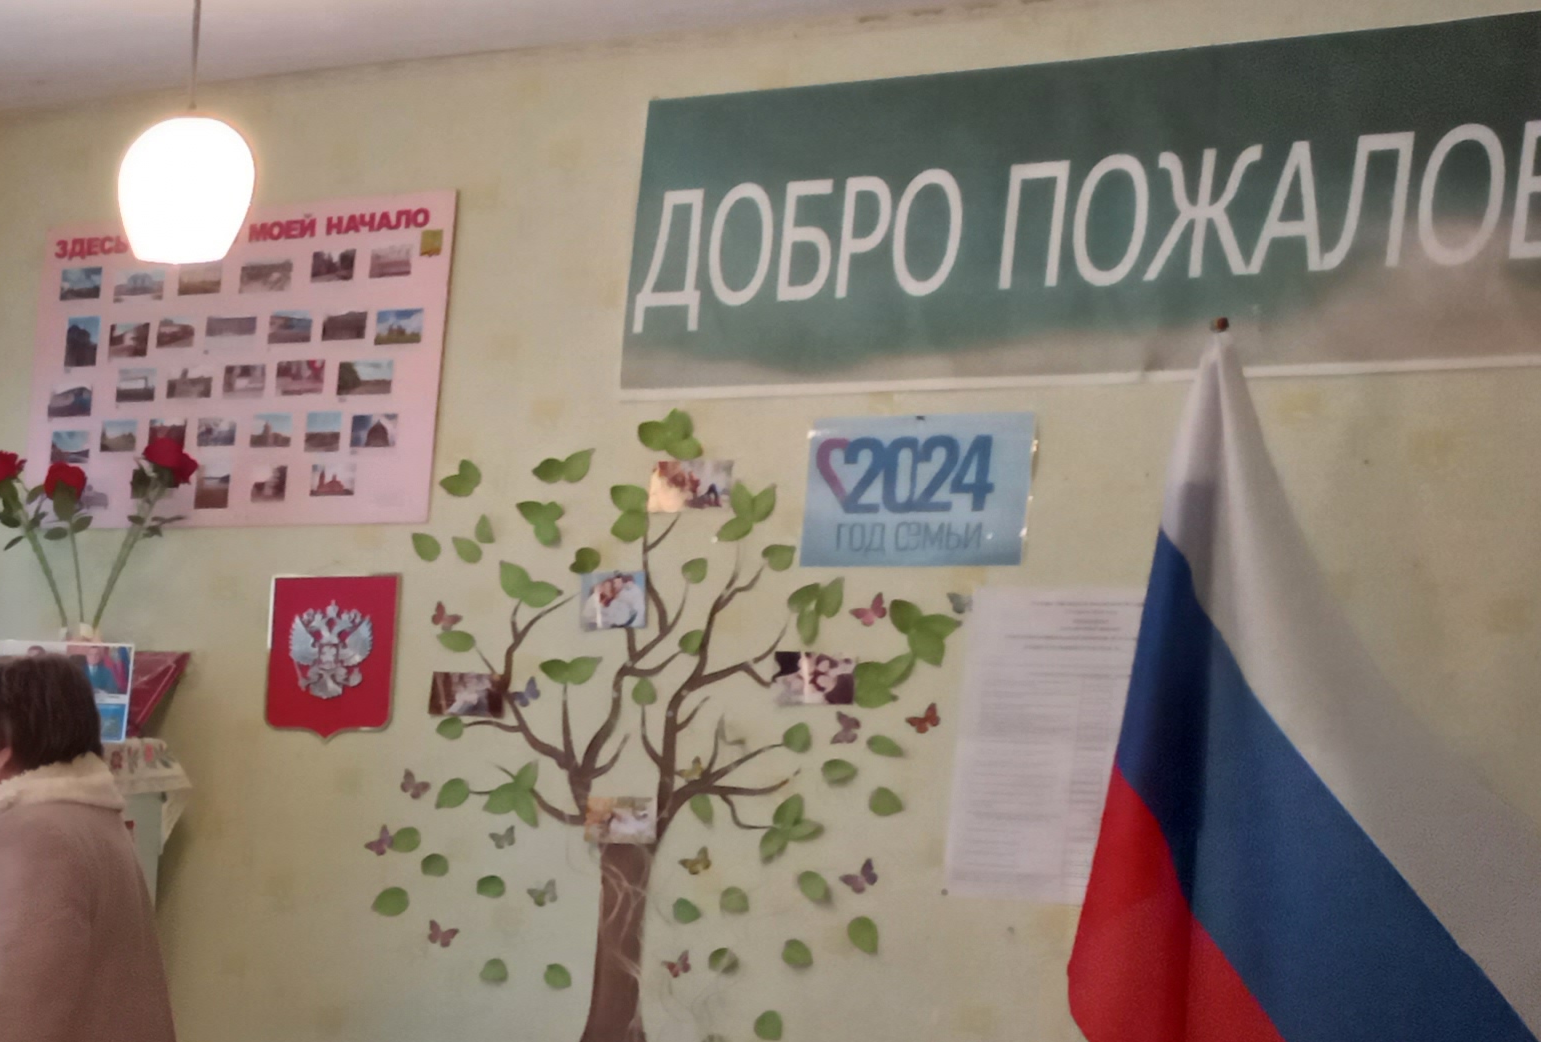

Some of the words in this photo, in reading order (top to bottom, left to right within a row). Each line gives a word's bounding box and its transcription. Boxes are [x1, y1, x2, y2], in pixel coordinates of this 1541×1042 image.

[249, 213, 316, 243] МОЕЙ
[326, 207, 430, 236] НАЧАЛО
[634, 169, 964, 335] ДОБРО
[841, 434, 993, 515] 2024
[836, 522, 886, 553] ГОД
[894, 521, 983, 552] СЕМЬИ
